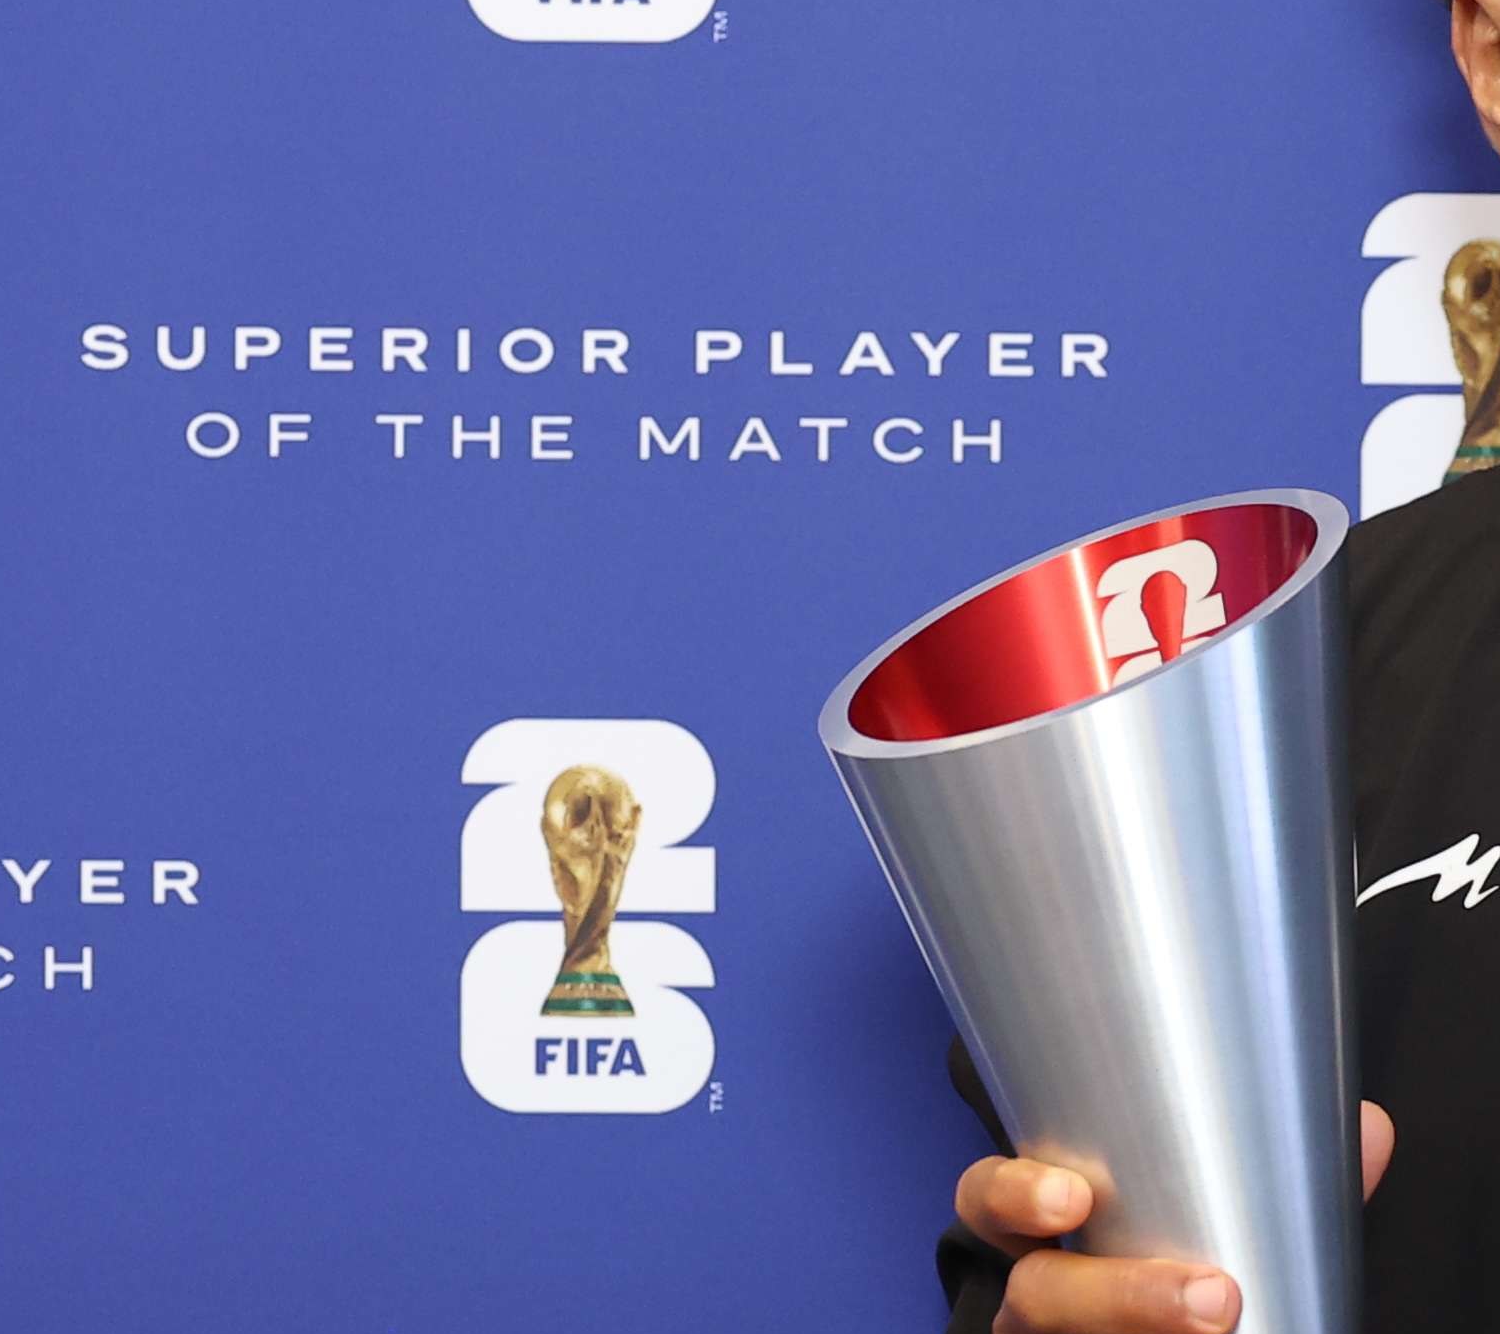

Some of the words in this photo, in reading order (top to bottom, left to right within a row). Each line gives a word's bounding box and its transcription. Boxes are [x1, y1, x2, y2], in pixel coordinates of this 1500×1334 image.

[80, 323, 630, 375] SUPERIOR
[694, 329, 1109, 379] PLAYER
[185, 411, 313, 459] OF
[374, 413, 575, 461] THE
[638, 415, 1002, 464] MATCH
[534, 1036, 646, 1077] FIFA
